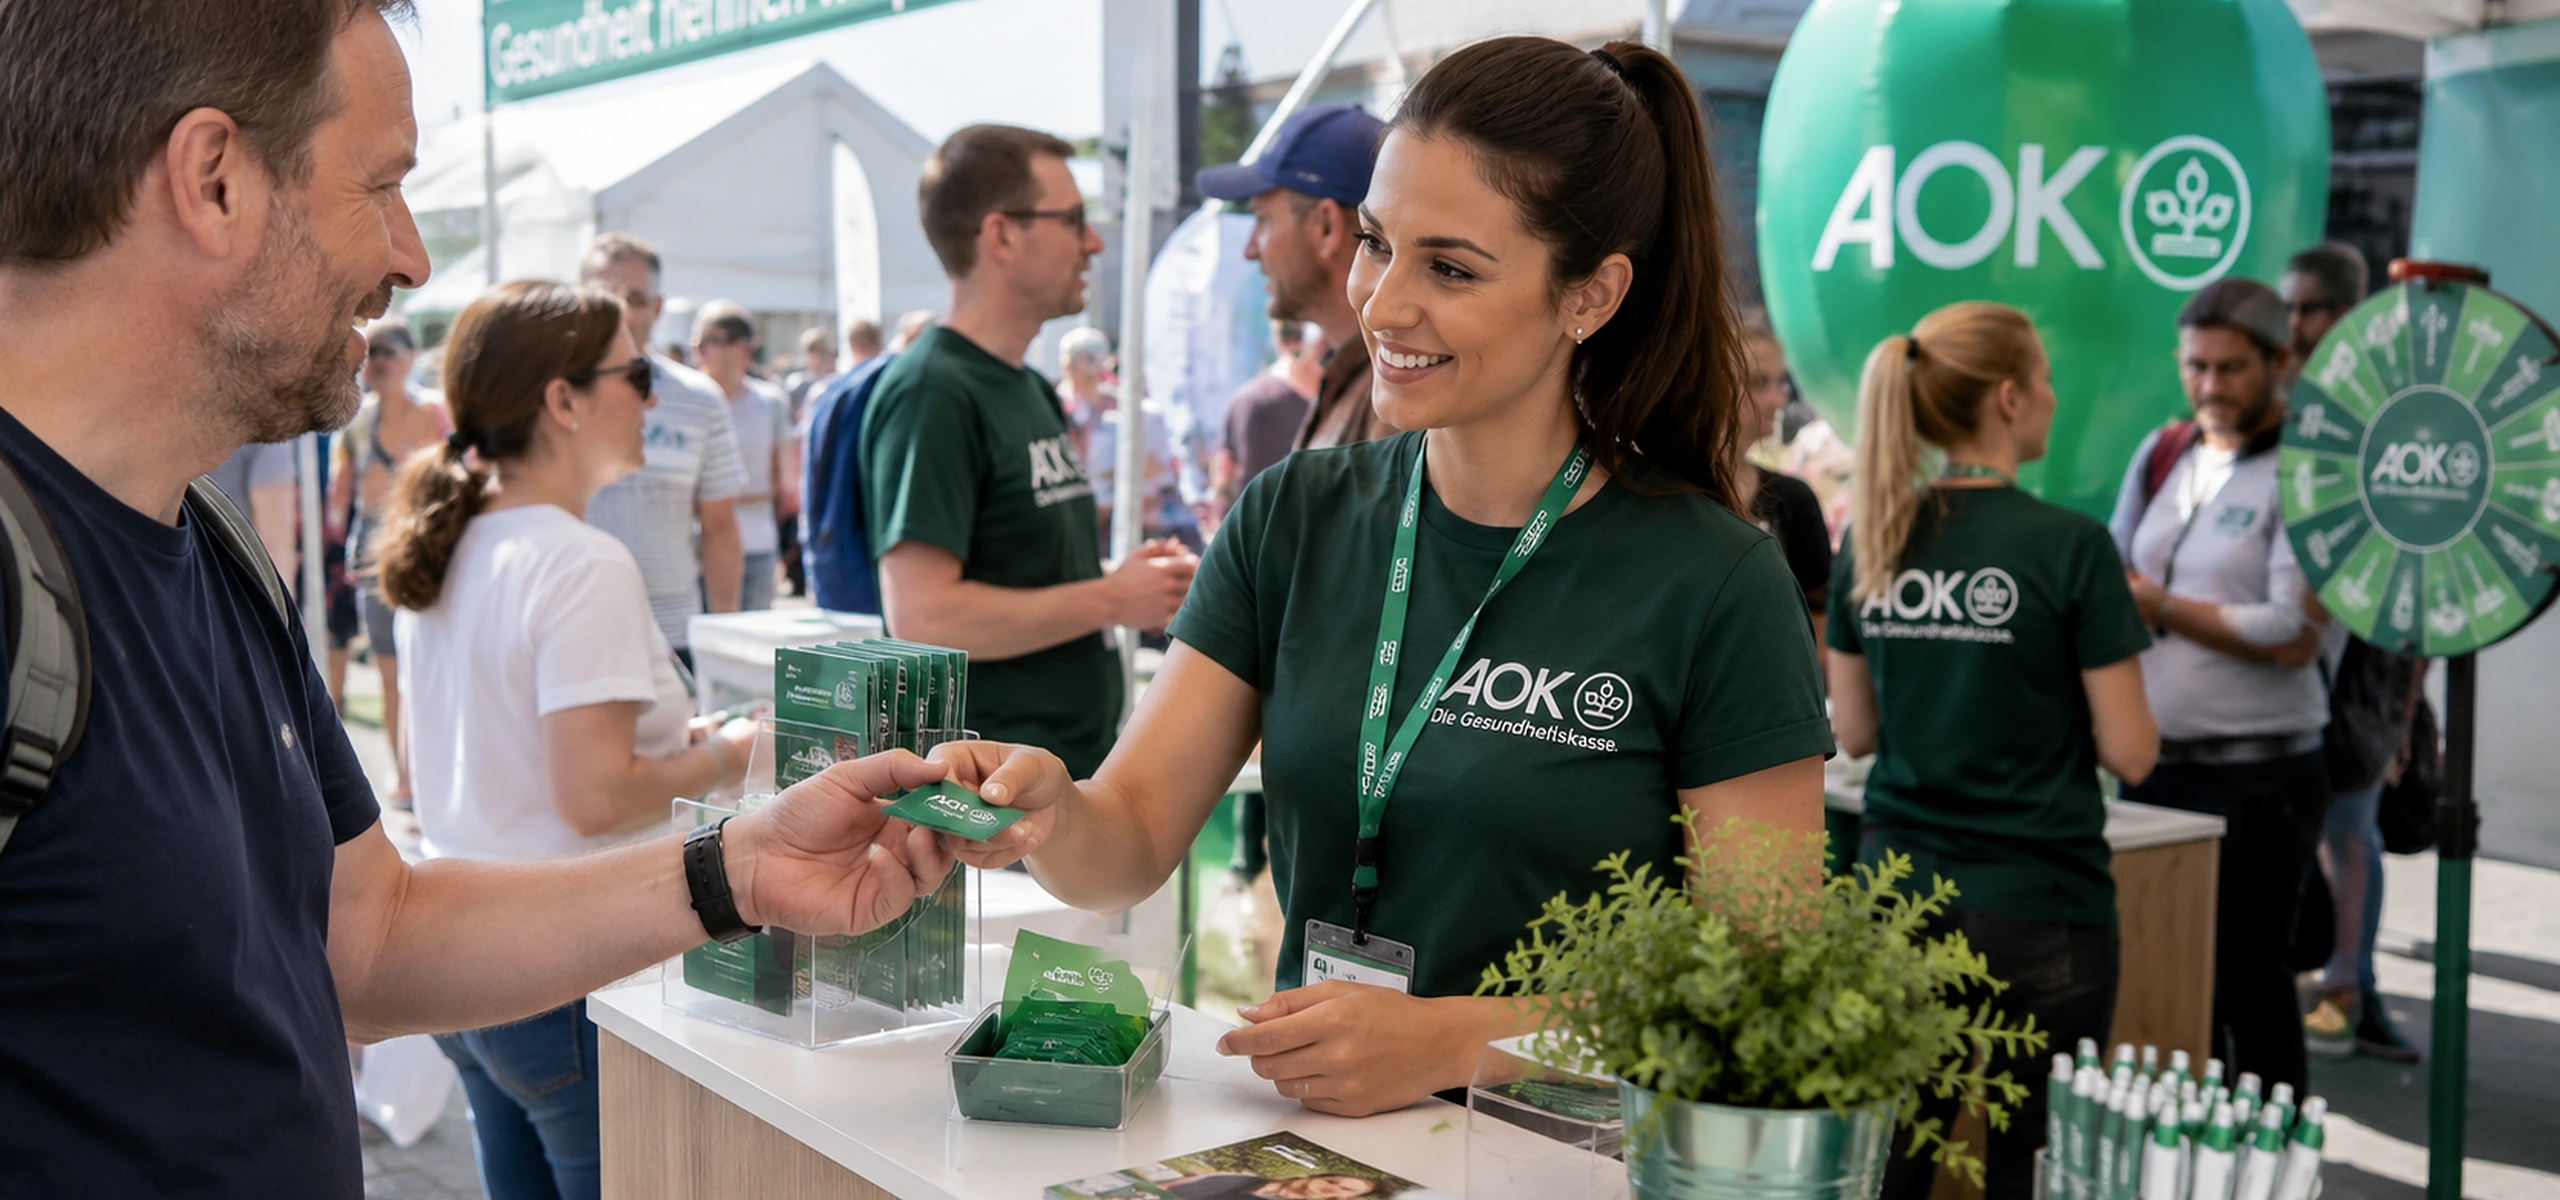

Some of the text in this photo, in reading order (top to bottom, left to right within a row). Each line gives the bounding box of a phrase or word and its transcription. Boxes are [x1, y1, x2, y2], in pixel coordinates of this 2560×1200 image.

[1811, 139, 2109, 270] AOK
[2370, 442, 2449, 484] AOK
[1860, 568, 1967, 621] AOK
[1439, 657, 1576, 720] AOK
